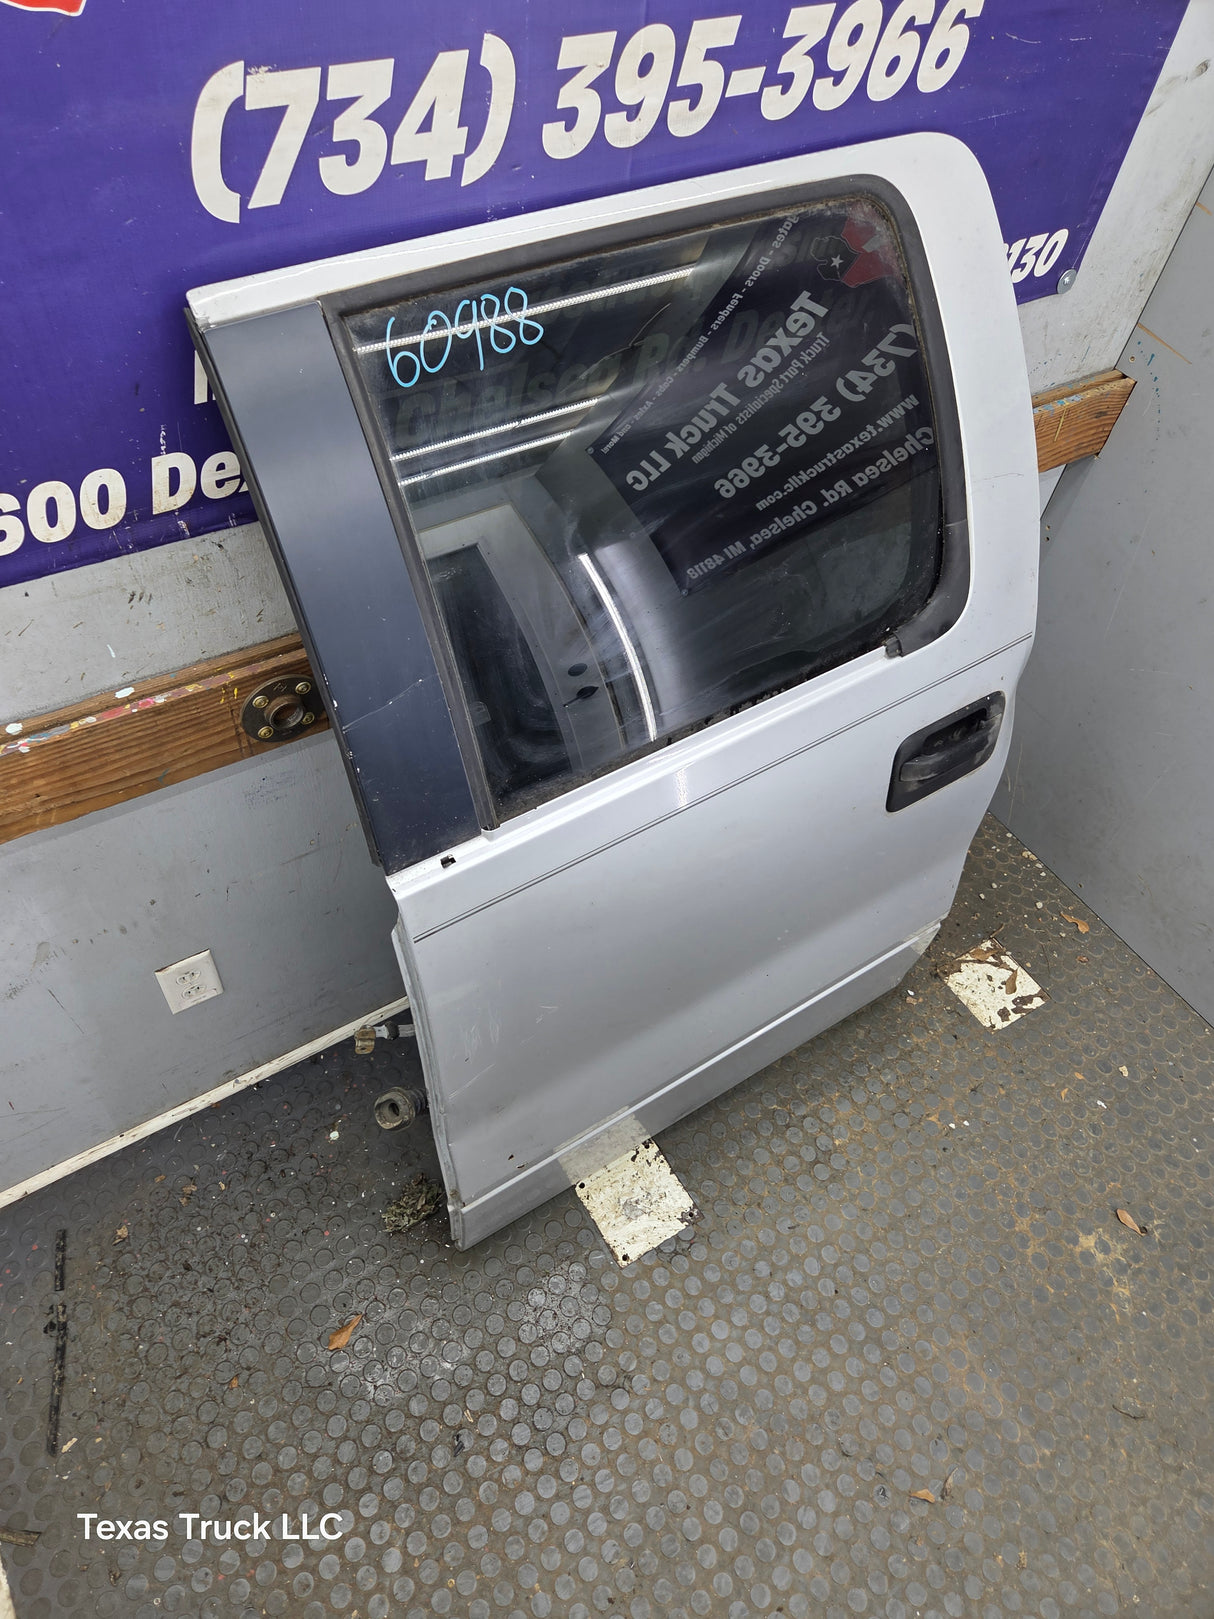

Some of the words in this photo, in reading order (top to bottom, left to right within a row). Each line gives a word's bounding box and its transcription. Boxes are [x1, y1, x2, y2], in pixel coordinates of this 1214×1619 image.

[191, 33, 516, 223] (734)
[542, 0, 985, 160] 395-3966
[1003, 228, 1069, 283] 130
[386, 287, 544, 388] 60988
